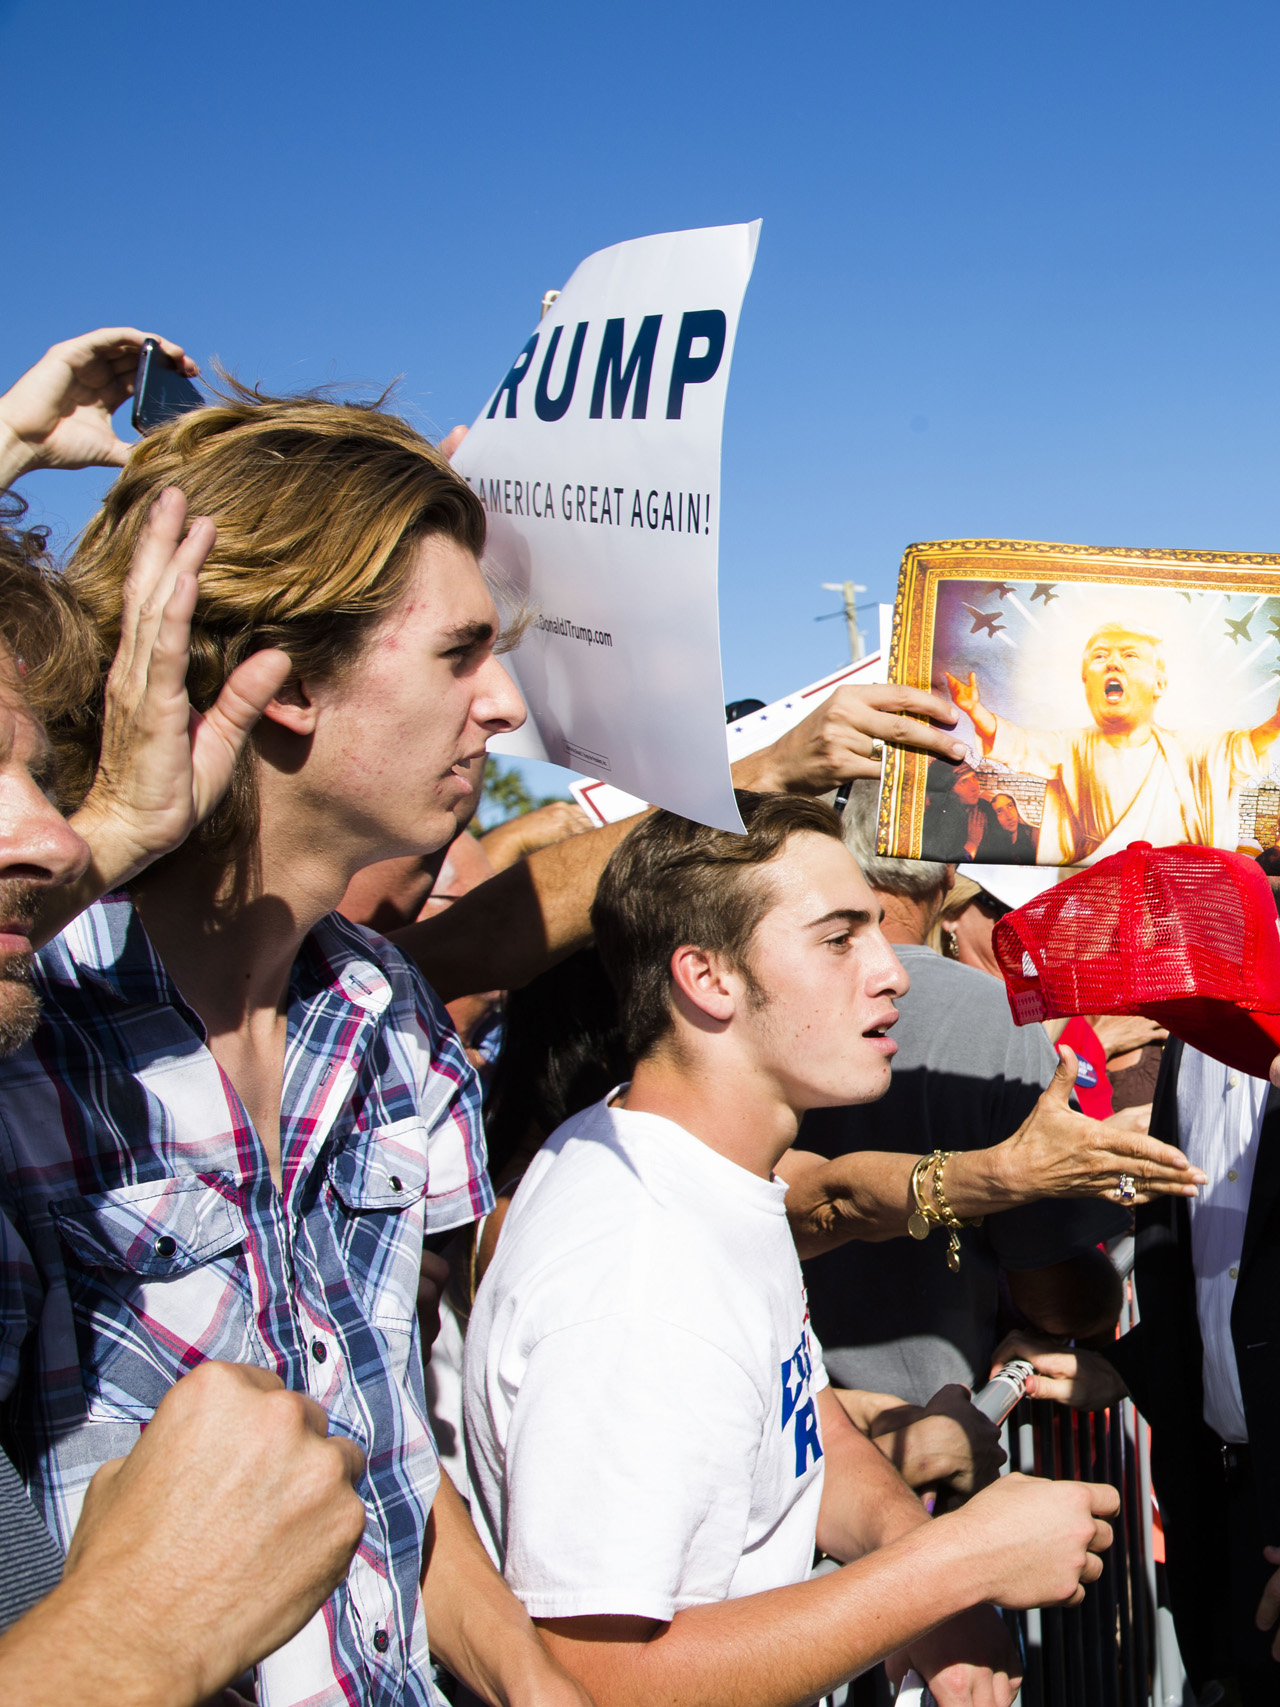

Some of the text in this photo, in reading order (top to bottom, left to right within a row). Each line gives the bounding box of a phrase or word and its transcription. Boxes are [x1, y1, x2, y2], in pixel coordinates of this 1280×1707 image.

[486, 309, 727, 422] RUMP
[479, 478, 711, 535] AMERICA GREAT AGAIN!
